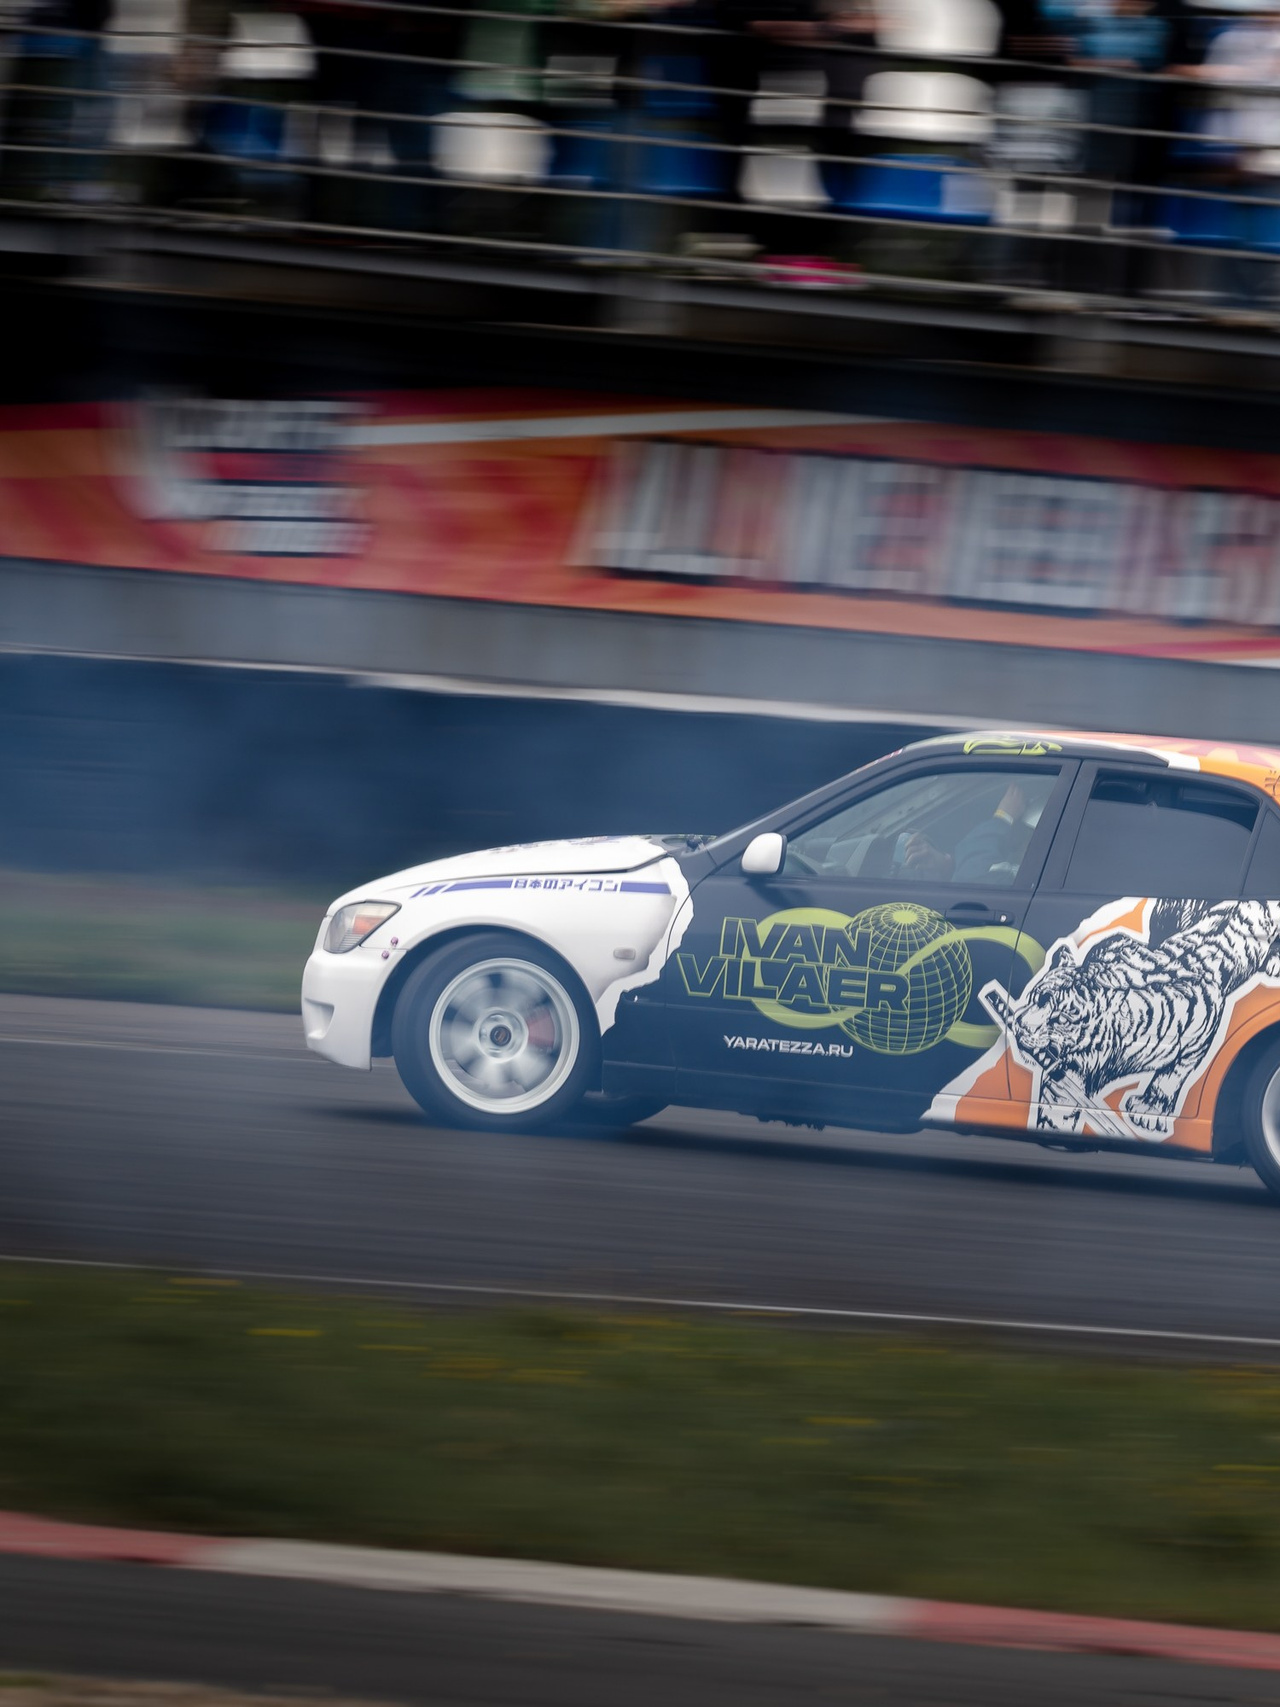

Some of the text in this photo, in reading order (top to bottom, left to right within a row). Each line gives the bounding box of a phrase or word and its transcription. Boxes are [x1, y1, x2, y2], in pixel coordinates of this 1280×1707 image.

[513, 878, 619, 892] 日本のアイコン
[719, 916, 873, 969] IVAN
[676, 953, 911, 1011] VILAER
[722, 1034, 855, 1059] YARATEZZA.RU
